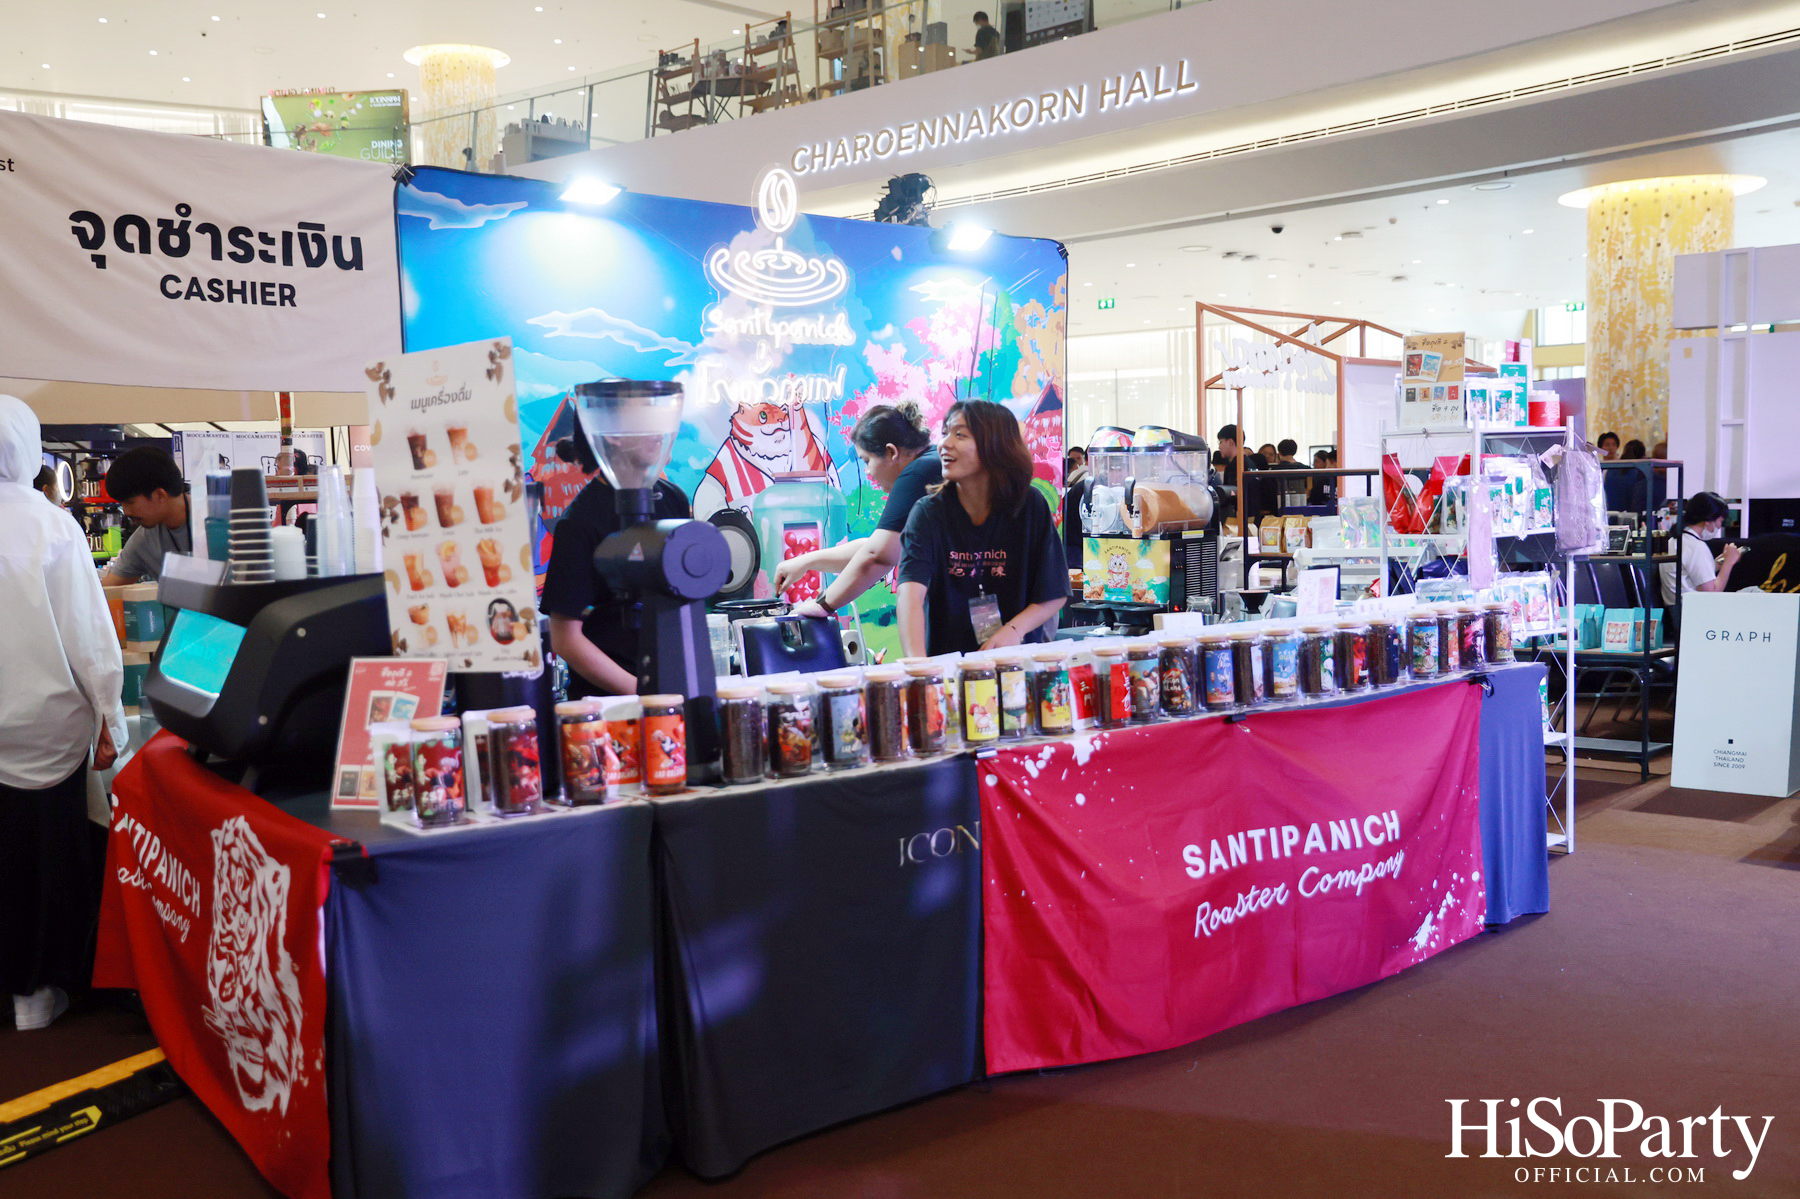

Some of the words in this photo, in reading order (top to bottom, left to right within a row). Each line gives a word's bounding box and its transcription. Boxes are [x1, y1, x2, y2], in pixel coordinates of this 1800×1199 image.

[790, 84, 1087, 175] CHAROENNAKORN
[1099, 59, 1199, 111] HALL
[360, 147, 404, 160] GUIDE
[68, 203, 364, 271] จุดชำระเงิน
[160, 274, 298, 307] CASHIER
[411, 383, 472, 413] เมนูเครื่องดื่ม
[1705, 630, 1772, 642] GRAPH
[1713, 749, 1747, 757] CHIANGMAI
[1715, 755, 1745, 763] THAILAND
[1182, 809, 1401, 879] SANTIPANICH
[1194, 882, 1289, 938] Roaster
[1298, 849, 1405, 896] Company
[18, 1136, 42, 1148] Please
[41, 1127, 60, 1140] mind
[74, 1117, 89, 1128] step
